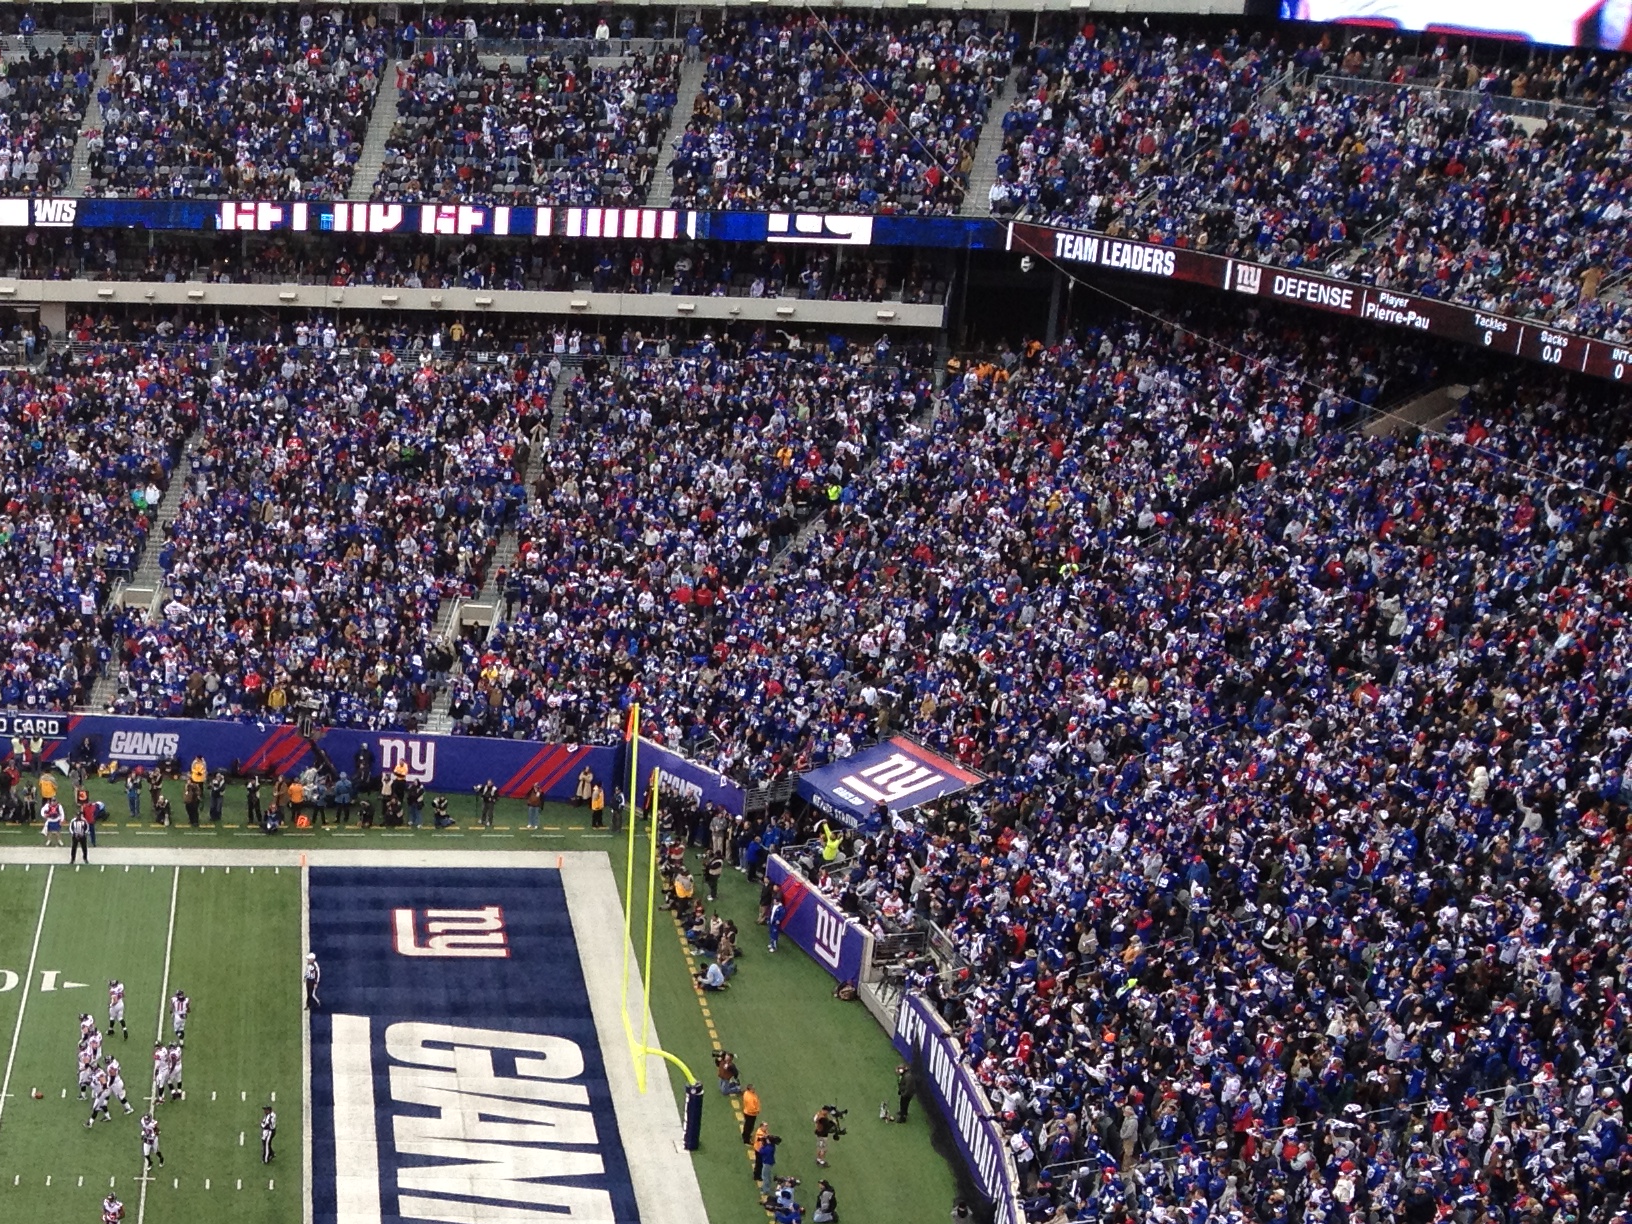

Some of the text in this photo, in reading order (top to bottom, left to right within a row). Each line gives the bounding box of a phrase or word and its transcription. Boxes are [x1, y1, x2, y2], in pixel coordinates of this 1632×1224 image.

[1056, 232, 1176, 276] TEAM LEADERS
[1274, 275, 1353, 309] DEFENSE
[1380, 292, 1409, 308] Player
[1366, 302, 1430, 330] Pierre-Pau
[1475, 313, 1508, 333] Tackles
[1484, 330, 1492, 346] 6
[1542, 347, 1562, 364] 0.0
[1614, 363, 1623, 379] 0
[13, 715, 59, 734] CARD
[110, 731, 179, 755] GIANTS
[897, 1001, 998, 1200] NEW YORK FOOTBALL
